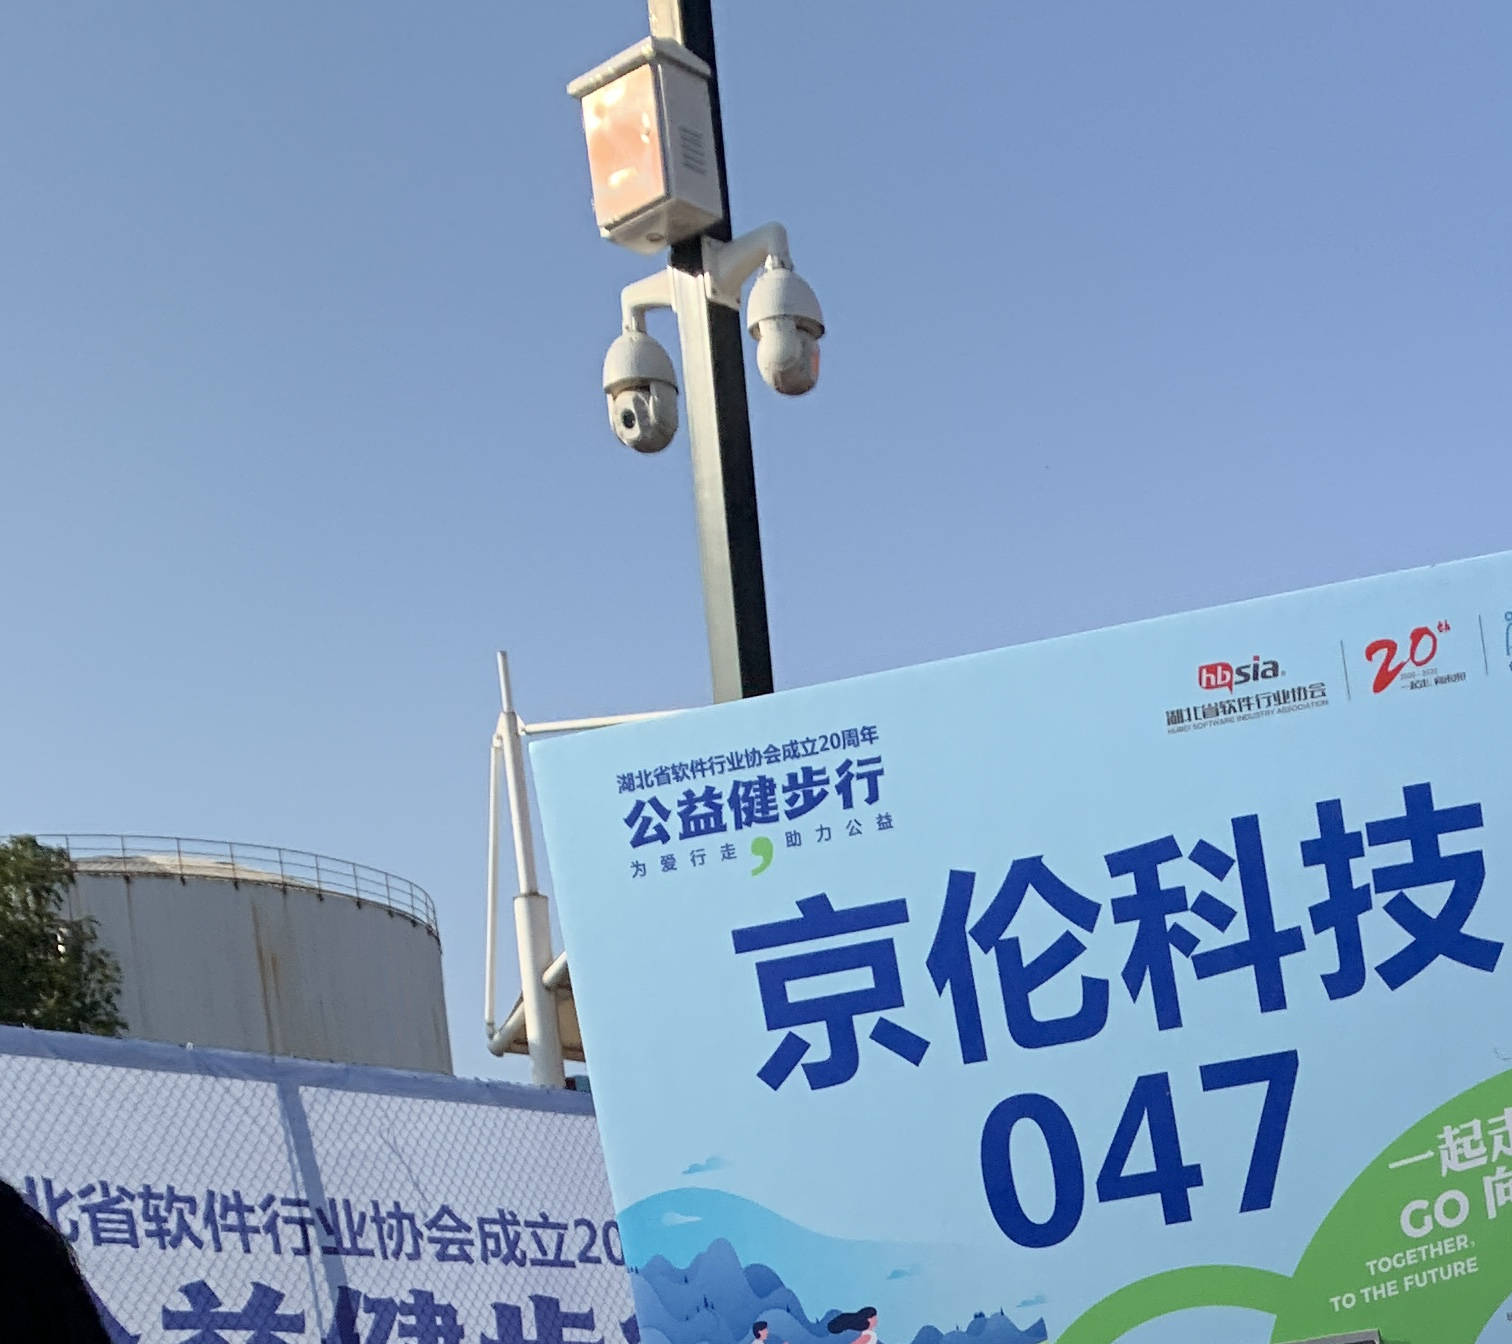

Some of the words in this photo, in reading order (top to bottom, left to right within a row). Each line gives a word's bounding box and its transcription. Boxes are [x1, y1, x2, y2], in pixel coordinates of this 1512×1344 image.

[1198, 655, 1280, 694] hbsia
[616, 724, 880, 794] 湖北省软件行业协会成立20周年
[623, 755, 885, 849] 公益健步行
[731, 781, 1505, 1092] 京伦科技
[979, 1048, 1300, 1249] 047
[1400, 1189, 1470, 1239] GO
[1329, 1292, 1358, 1313] TO
[1360, 1278, 1400, 1305] THE
[1403, 1256, 1480, 1293] FUTURE
[1365, 1234, 1476, 1277] TOGETHER,
